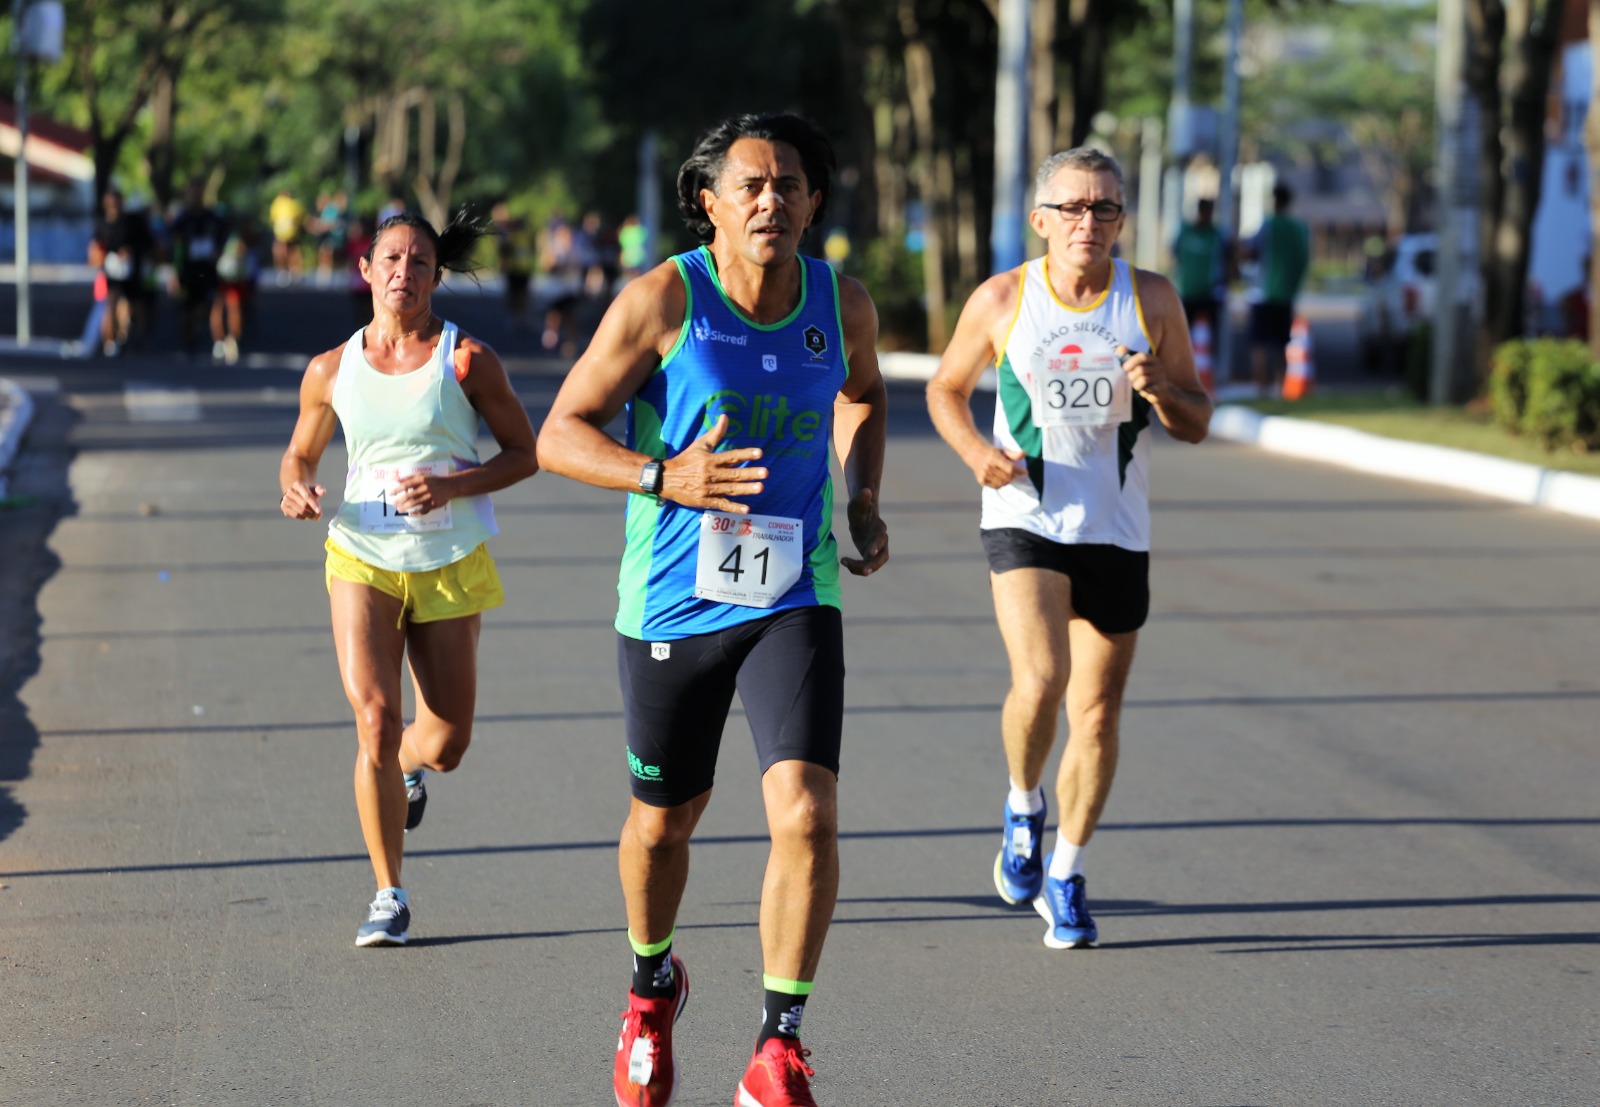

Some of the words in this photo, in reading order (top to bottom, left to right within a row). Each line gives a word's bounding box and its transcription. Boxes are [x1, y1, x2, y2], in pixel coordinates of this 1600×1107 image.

[711, 330, 748, 346] Sicredi
[1042, 326, 1069, 346] SÃO
[1047, 377, 1113, 409] 320
[718, 544, 769, 585] 41
